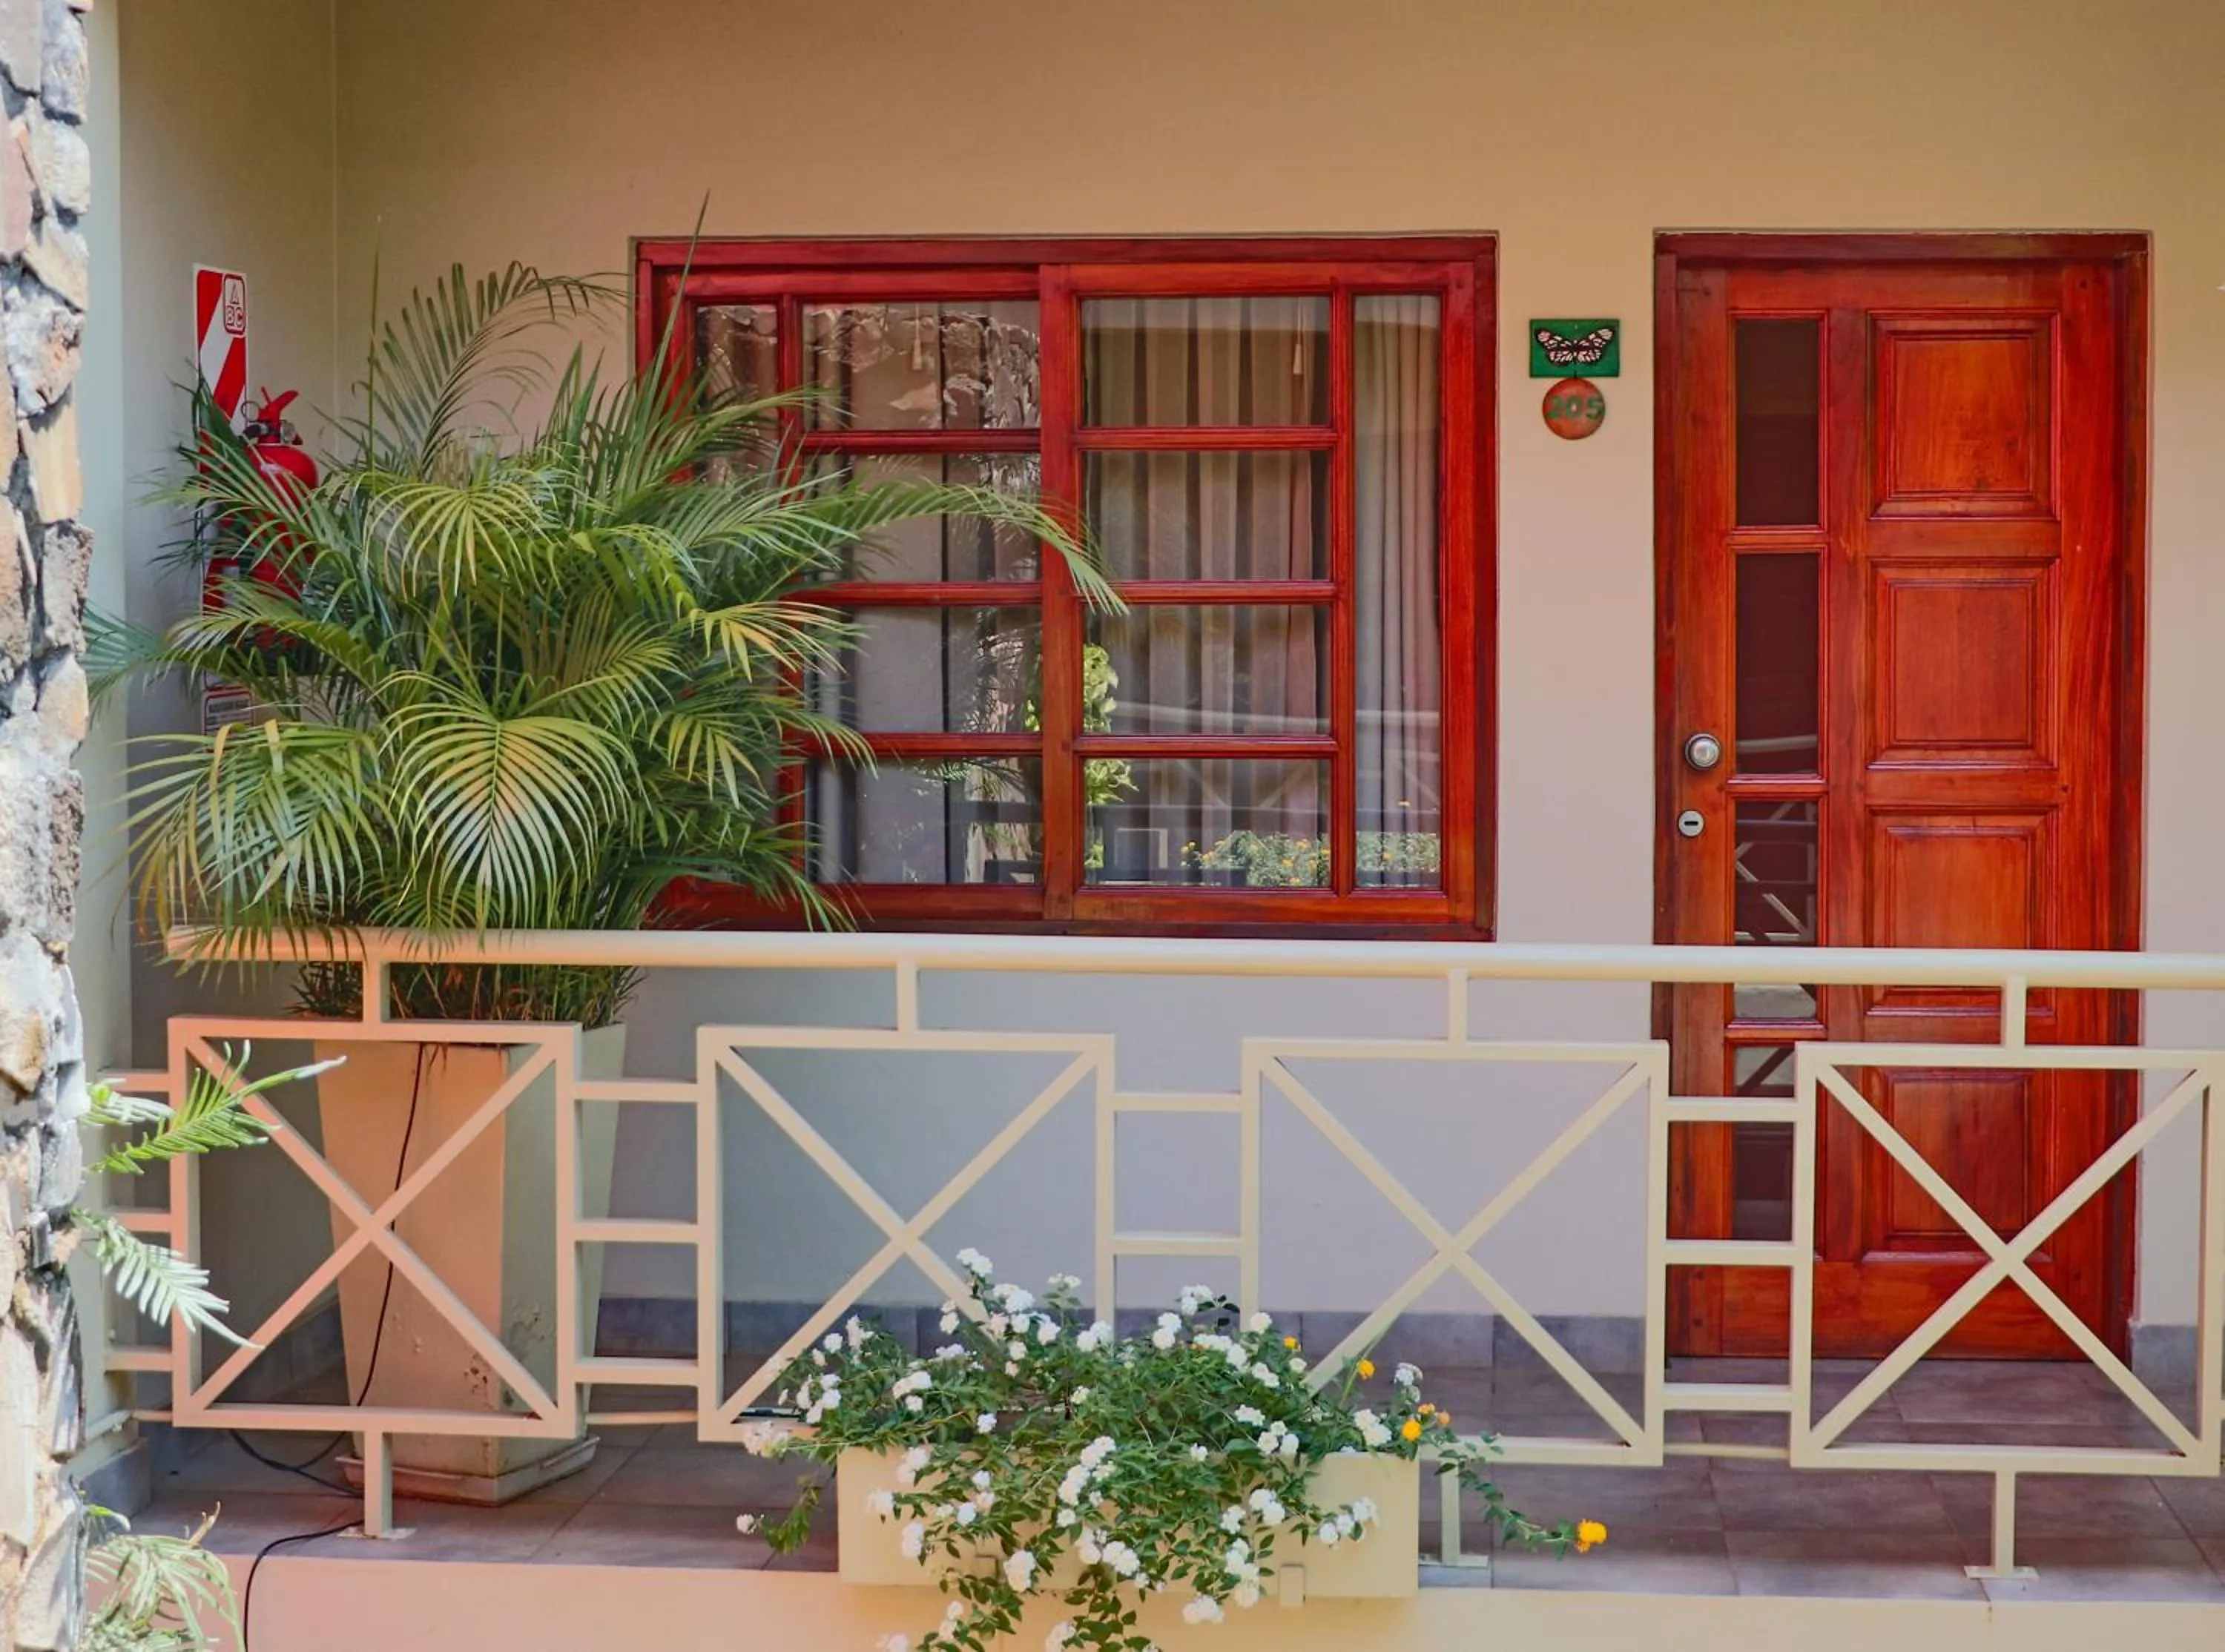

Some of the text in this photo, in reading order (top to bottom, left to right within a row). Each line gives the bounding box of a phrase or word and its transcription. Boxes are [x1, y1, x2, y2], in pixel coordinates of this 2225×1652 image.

[229, 283, 241, 305] A
[225, 305, 244, 328] BC
[1546, 394, 1605, 421] 205
